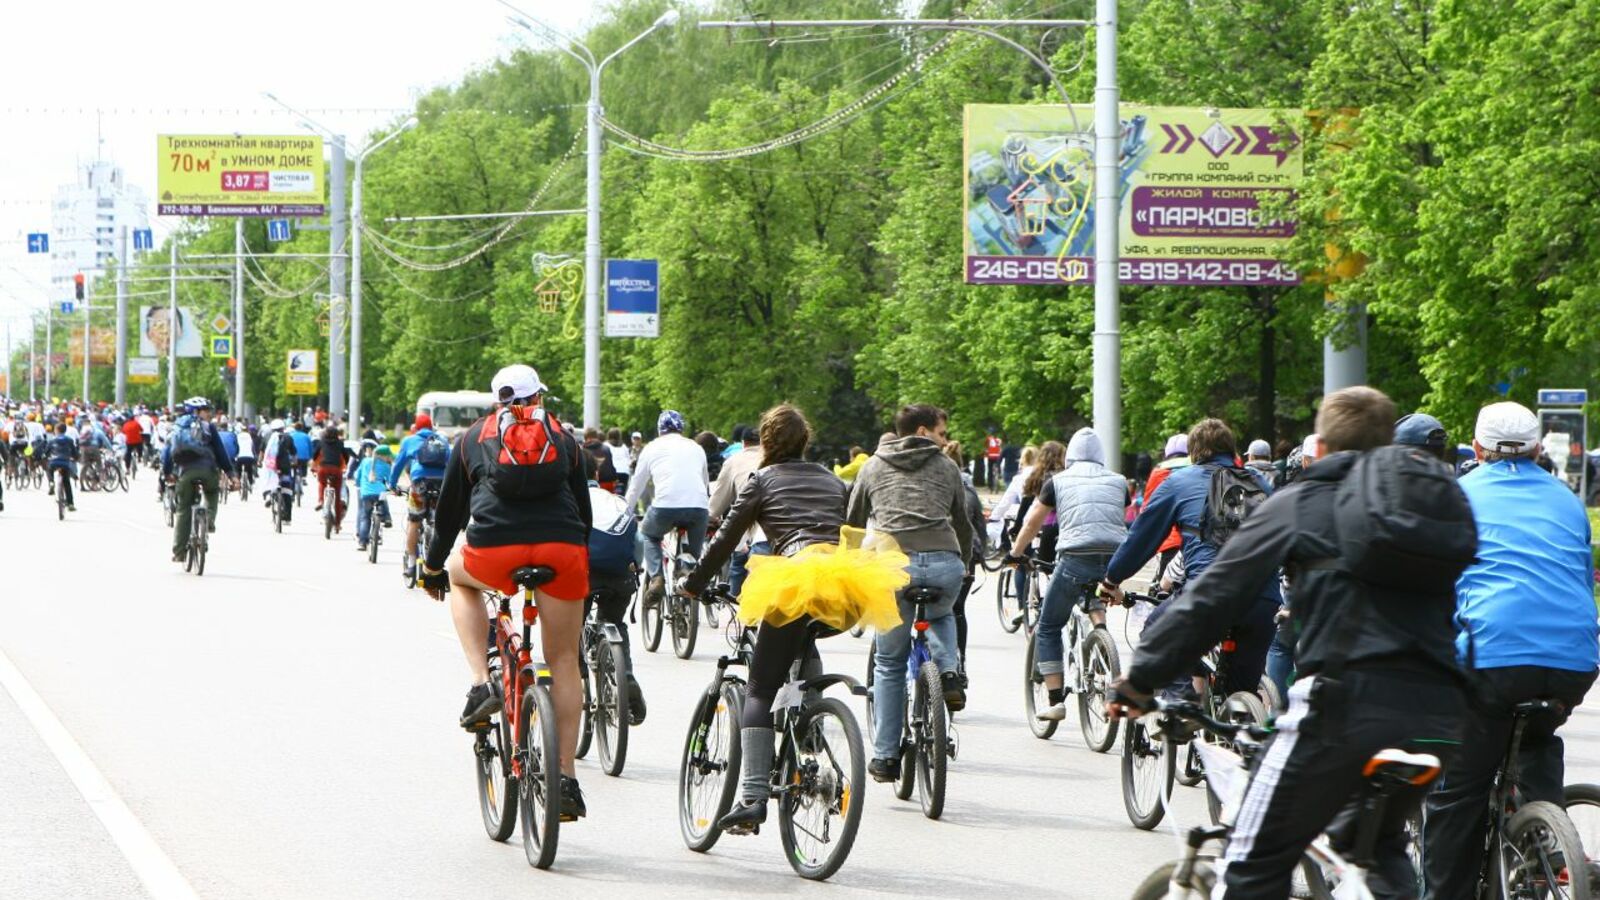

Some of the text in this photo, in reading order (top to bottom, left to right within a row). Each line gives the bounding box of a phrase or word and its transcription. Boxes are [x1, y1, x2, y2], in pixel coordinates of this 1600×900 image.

[168, 137, 314, 151] Трехкомнатная квартира
[221, 158, 227, 166] в
[232, 155, 275, 166] УМНОМ
[279, 155, 313, 168] ДОМЕ
[1207, 162, 1229, 171] ООО
[224, 174, 250, 188] 3,87
[1196, 171, 1254, 183] КОМПАНИЙ
[1151, 188, 1202, 198] ЖИЛОЙ
